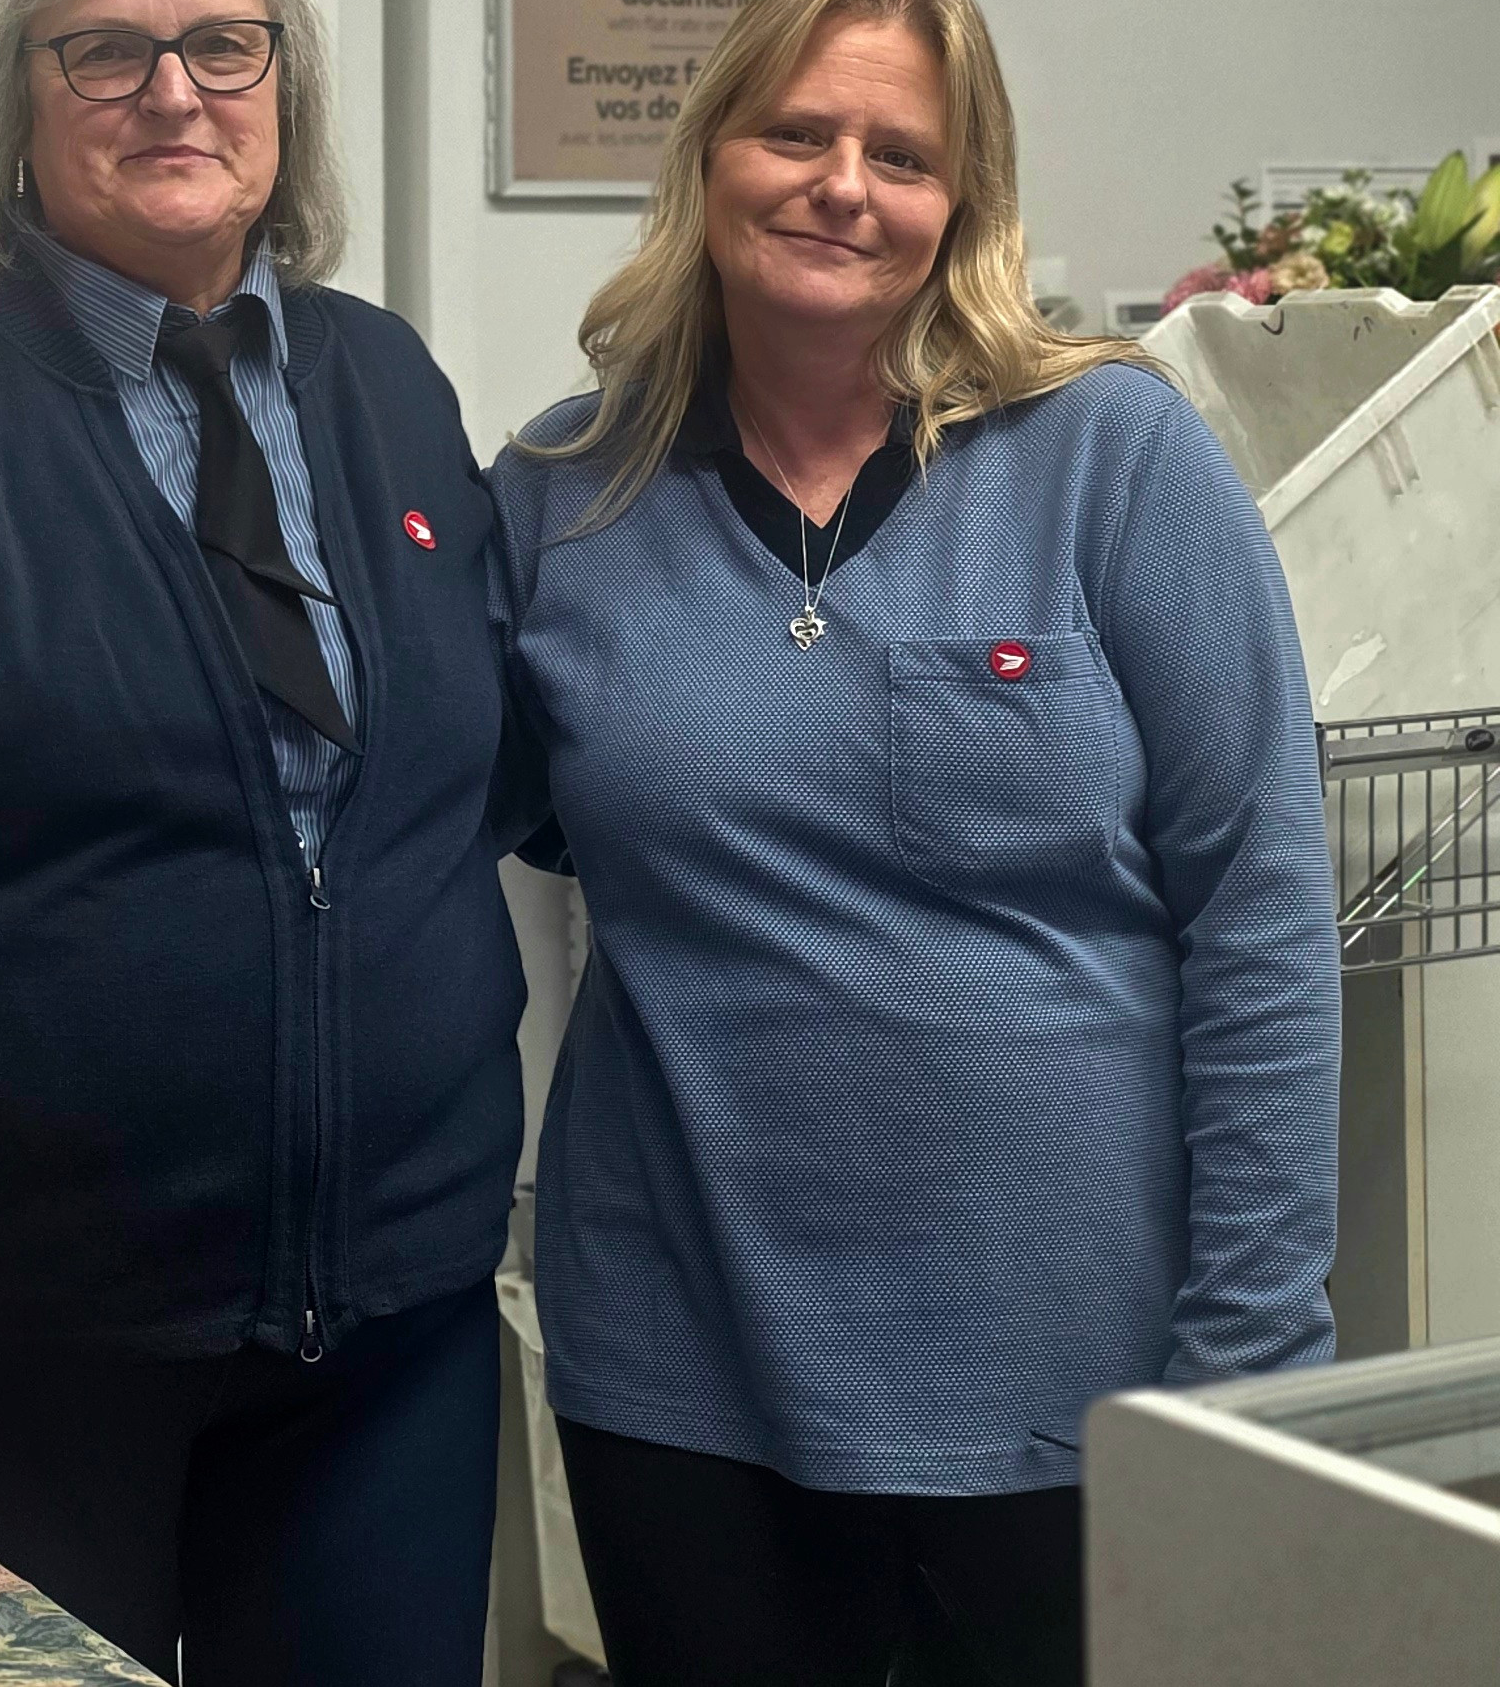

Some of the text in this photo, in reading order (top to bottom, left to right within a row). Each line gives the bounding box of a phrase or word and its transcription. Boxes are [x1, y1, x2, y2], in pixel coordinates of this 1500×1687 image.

[567, 56, 679, 91] Envoyez
[595, 93, 680, 121] vos do
